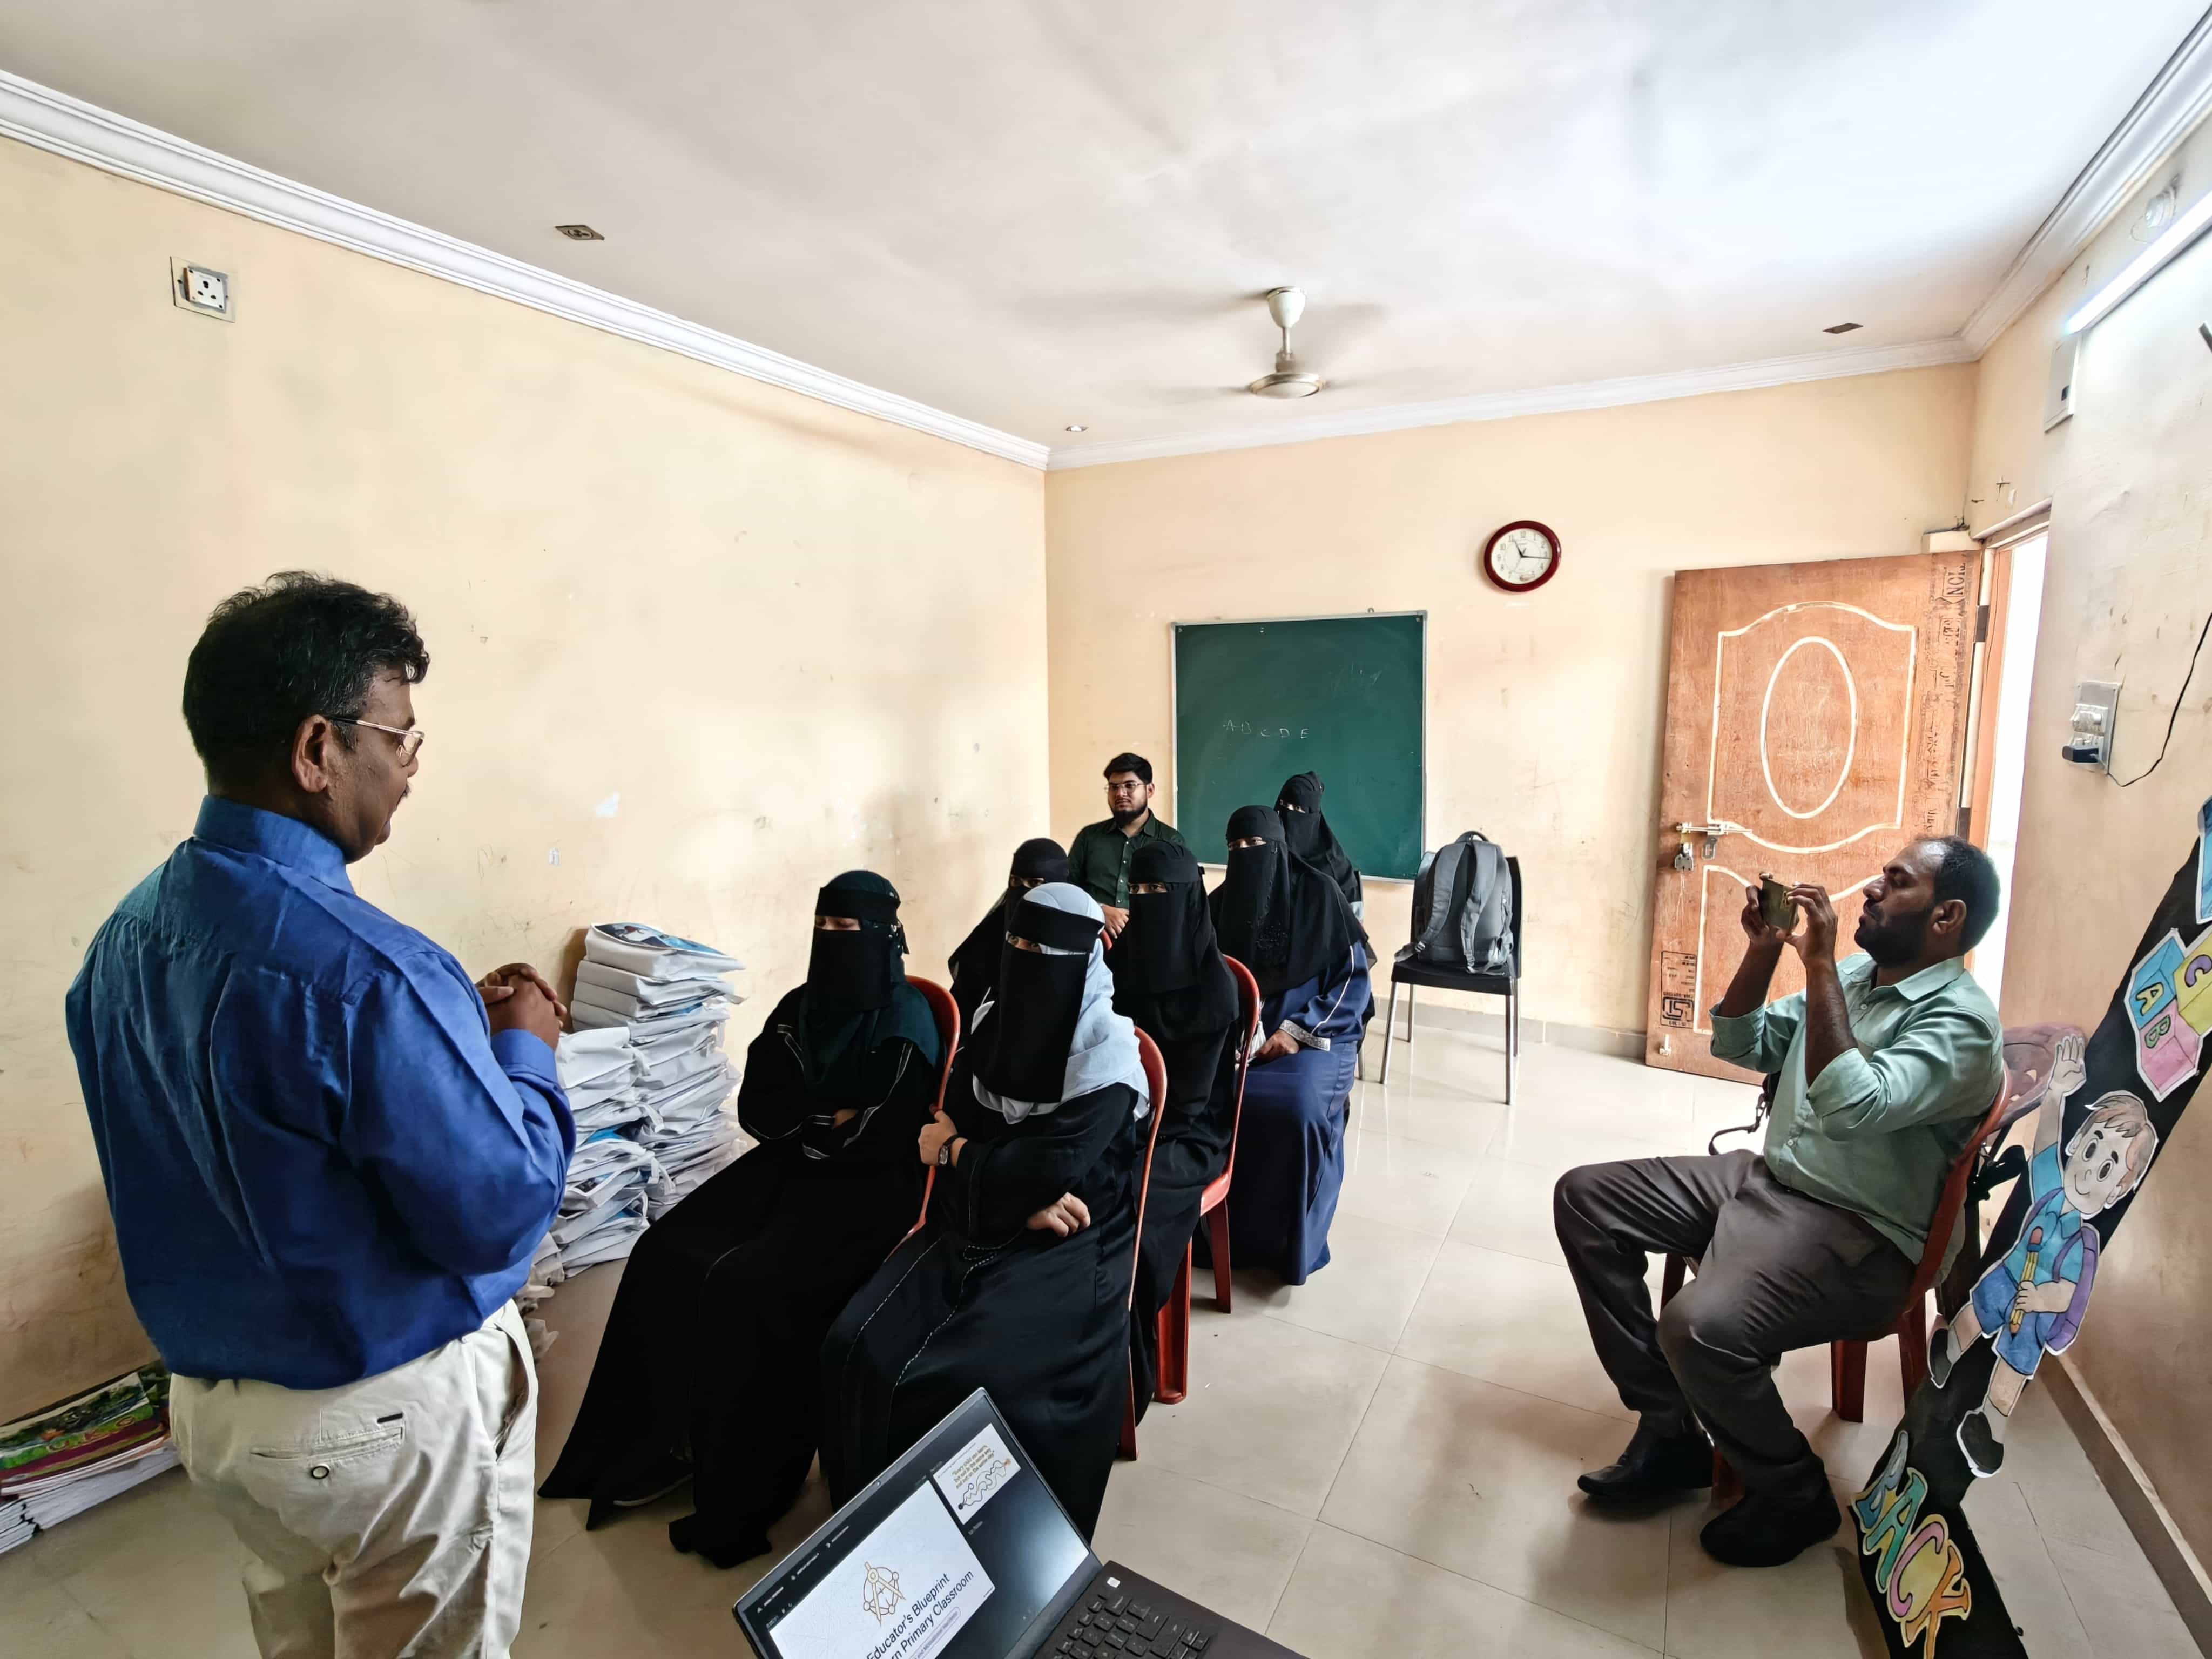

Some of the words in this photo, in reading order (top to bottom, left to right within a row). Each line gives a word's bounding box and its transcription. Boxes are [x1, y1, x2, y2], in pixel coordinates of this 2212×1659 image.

[1279, 728, 1290, 738] D
[1300, 728, 1310, 739] E
[2184, 954, 2212, 987] C
[2135, 982, 2164, 1016] A
[2144, 1015, 2171, 1049] B
[866, 1615, 913, 1659] Educator's
[911, 1573, 950, 1616] Blueprint
[900, 1614, 934, 1653] Primary
[933, 1570, 974, 1616] Classroom
